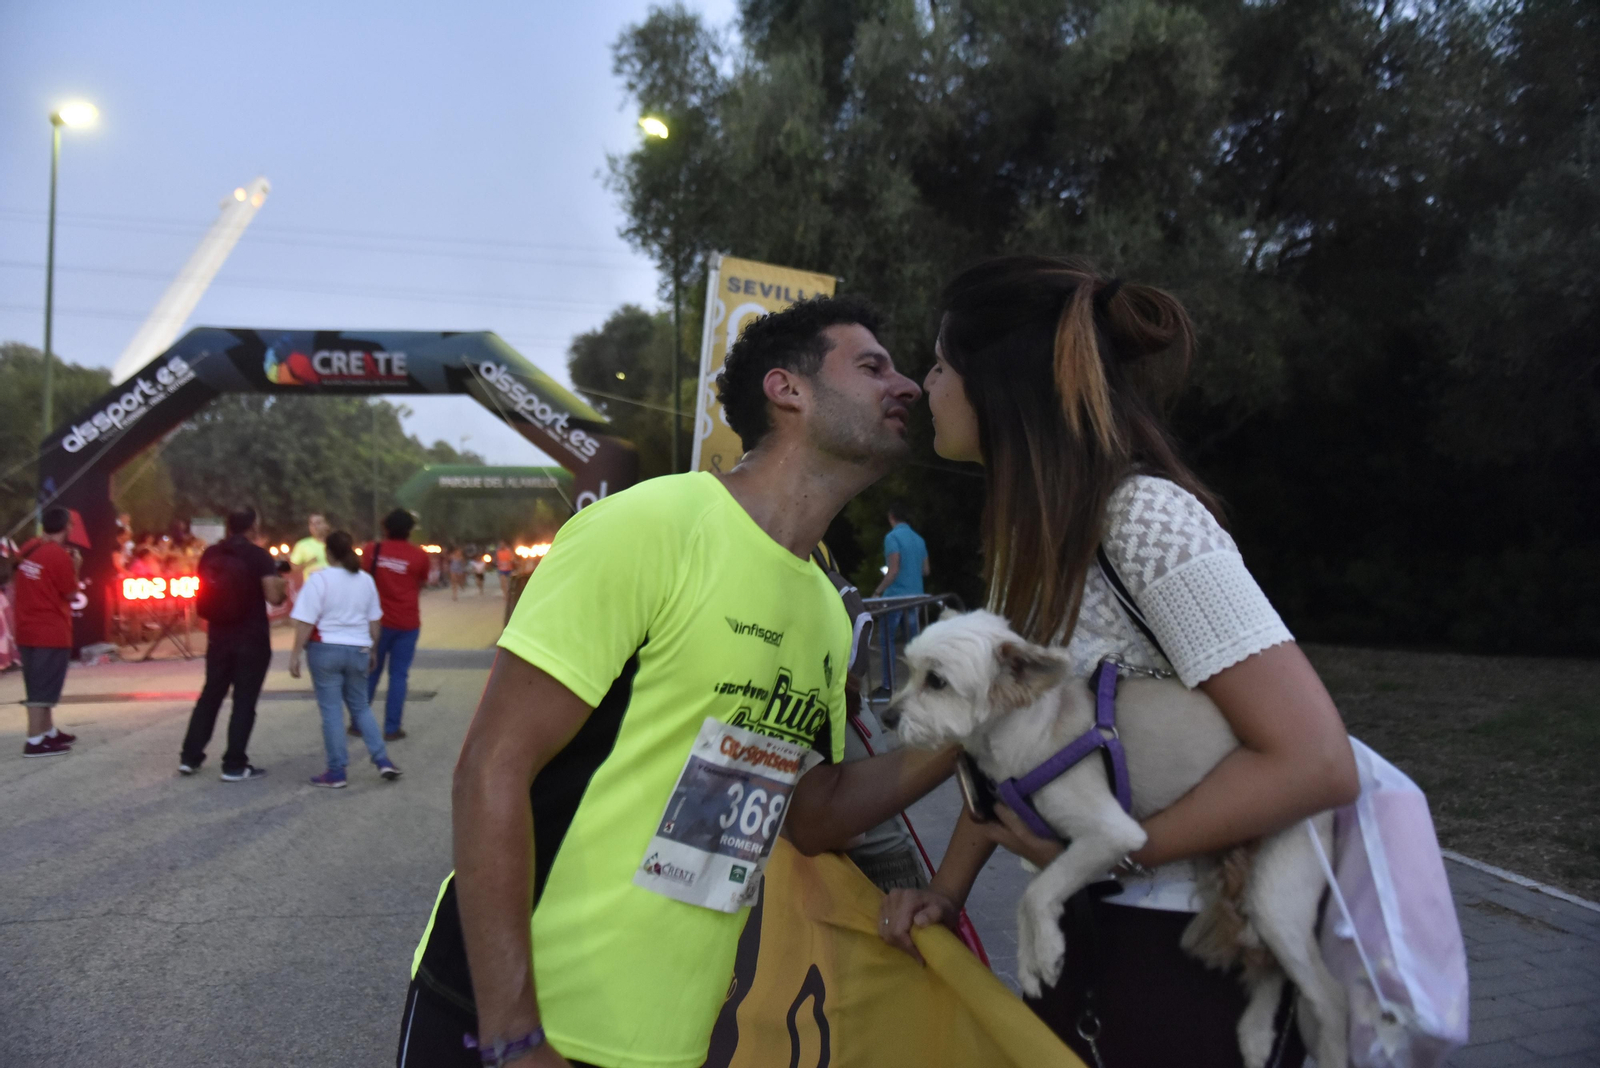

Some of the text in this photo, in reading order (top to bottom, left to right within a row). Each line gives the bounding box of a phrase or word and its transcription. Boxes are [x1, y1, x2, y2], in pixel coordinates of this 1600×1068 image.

[312, 350, 408, 376] CREATE
[62, 355, 190, 453] alssport.es
[479, 360, 600, 457] alssport.es
[720, 782, 786, 840] 368
